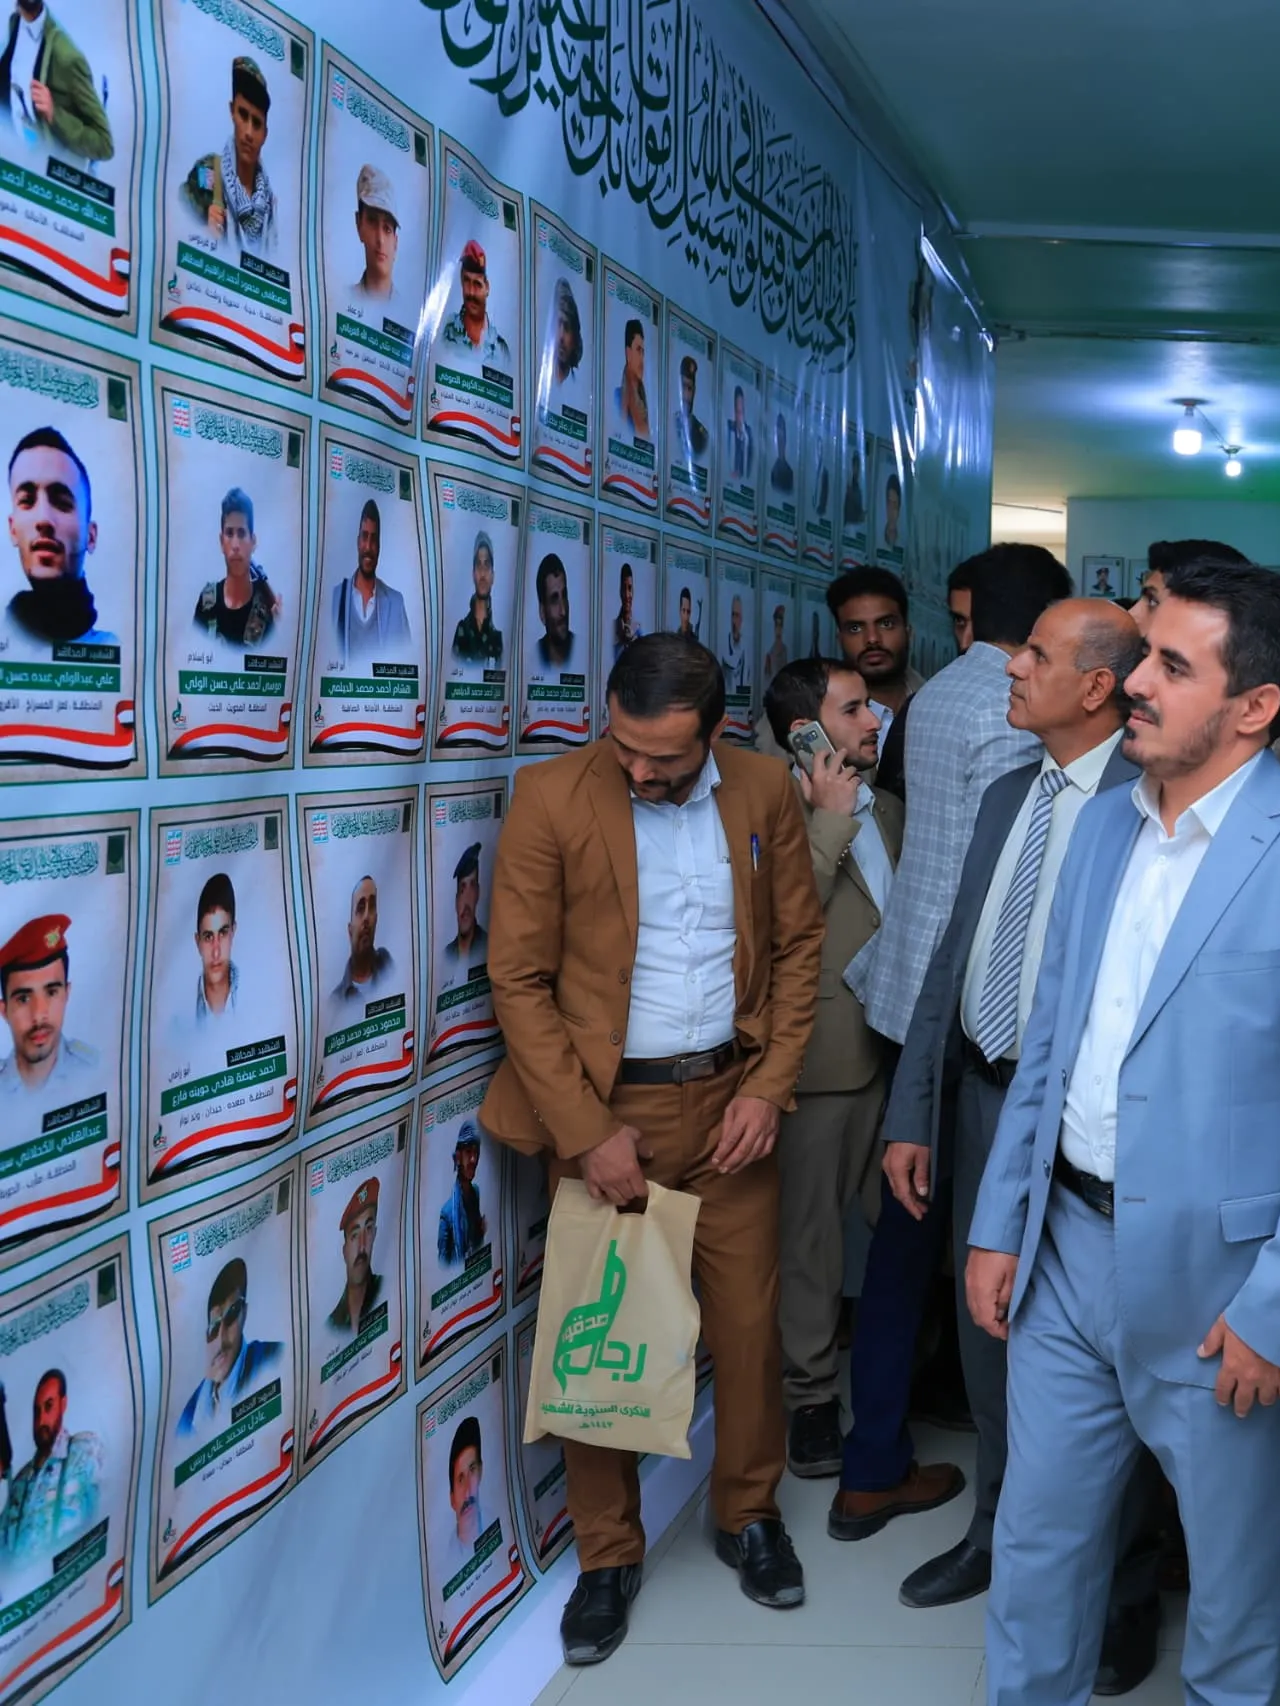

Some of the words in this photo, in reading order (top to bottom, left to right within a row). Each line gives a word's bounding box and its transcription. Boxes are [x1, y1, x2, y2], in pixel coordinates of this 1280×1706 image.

[26, 182, 54, 200] محمد
[54, 194, 80, 212] محمد
[226, 272, 240, 285] أحمد
[240, 277, 260, 294] محمود
[96, 673, 114, 688] علي
[209, 680, 228, 692] حسن
[229, 677, 245, 693] علي
[246, 677, 262, 690] أحمد
[375, 681, 392, 694] أحمد
[328, 682, 354, 695] الديلمي
[355, 685, 374, 693] محمد
[392, 683, 411, 696] هشام
[72, 701, 103, 711] المنطقة
[382, 705, 403, 713] المنطقة
[362, 1024, 379, 1038] حمود
[380, 1017, 401, 1032] محمود
[346, 1030, 362, 1043] محمد
[258, 1059, 276, 1077] أحمد
[211, 1075, 235, 1094] هادي
[250, 1086, 274, 1102] المنطقة
[540, 1401, 575, 1415] للشهيد
[575, 1404, 618, 1417] السنوية
[247, 1411, 266, 1430] عادل
[225, 1424, 246, 1444] محمد
